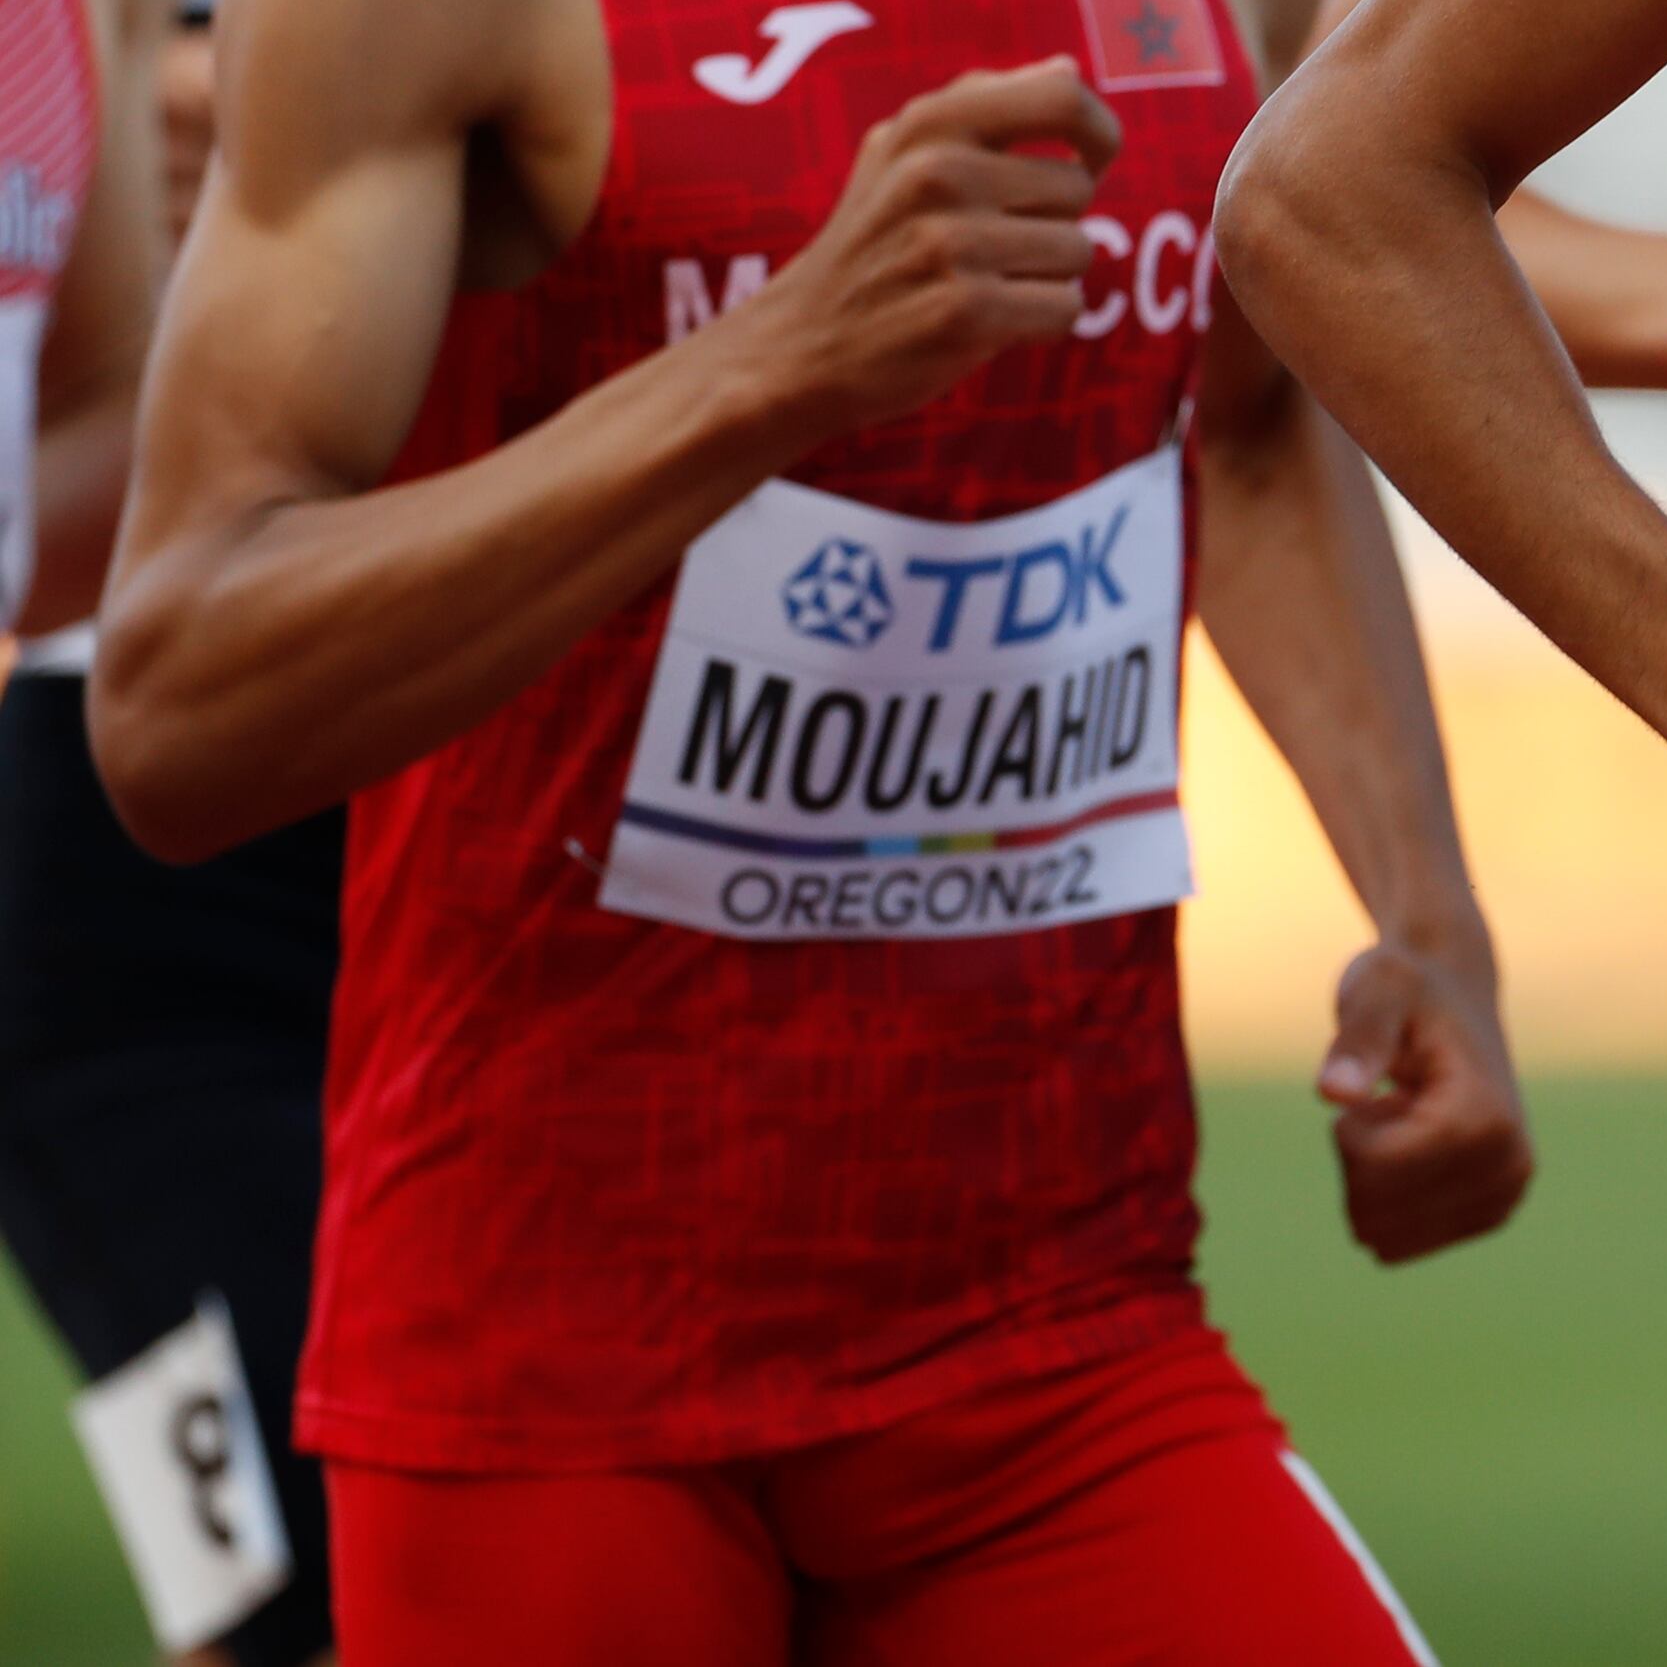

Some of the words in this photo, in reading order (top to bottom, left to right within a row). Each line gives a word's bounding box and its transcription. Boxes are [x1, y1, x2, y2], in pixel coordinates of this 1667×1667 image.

[905, 502, 1130, 653] TDK
[675, 644, 1151, 814] MOUJAHID
[719, 845, 1099, 929] OREGON22
